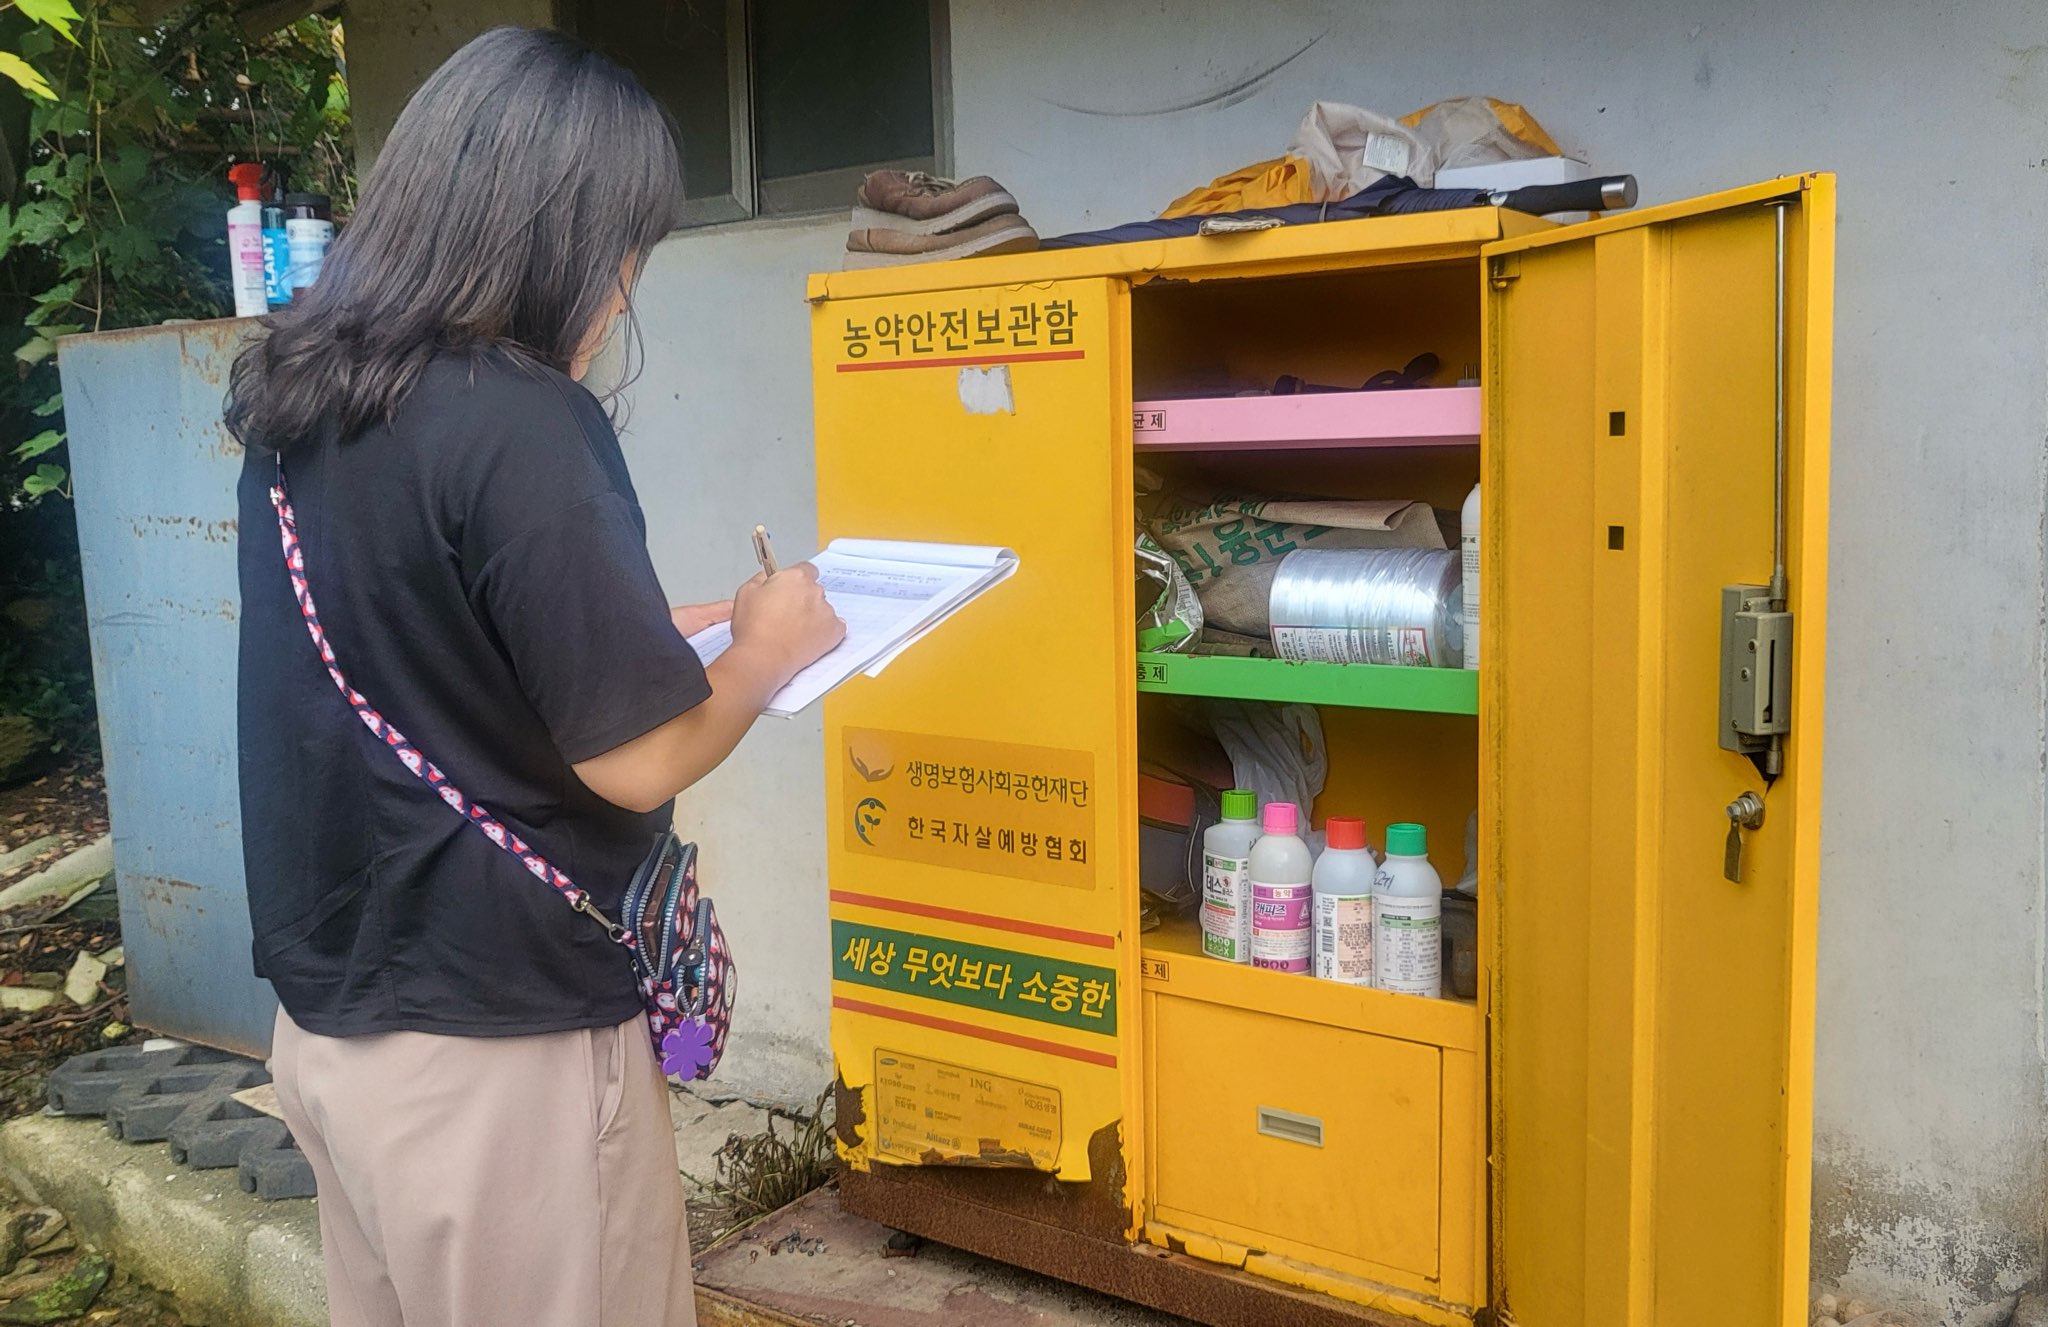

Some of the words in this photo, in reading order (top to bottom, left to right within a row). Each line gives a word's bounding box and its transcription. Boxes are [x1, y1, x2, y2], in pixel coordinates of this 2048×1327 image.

[262, 234, 278, 298] PLANT
[843, 299, 1079, 358] 농약안전보관함
[905, 760, 1089, 808] 생명보험사회공헌재단
[842, 937, 897, 976] 세상
[902, 947, 1013, 1000] 무엇보다
[1018, 971, 1112, 1019] 소중한
[969, 1077, 992, 1094] ING
